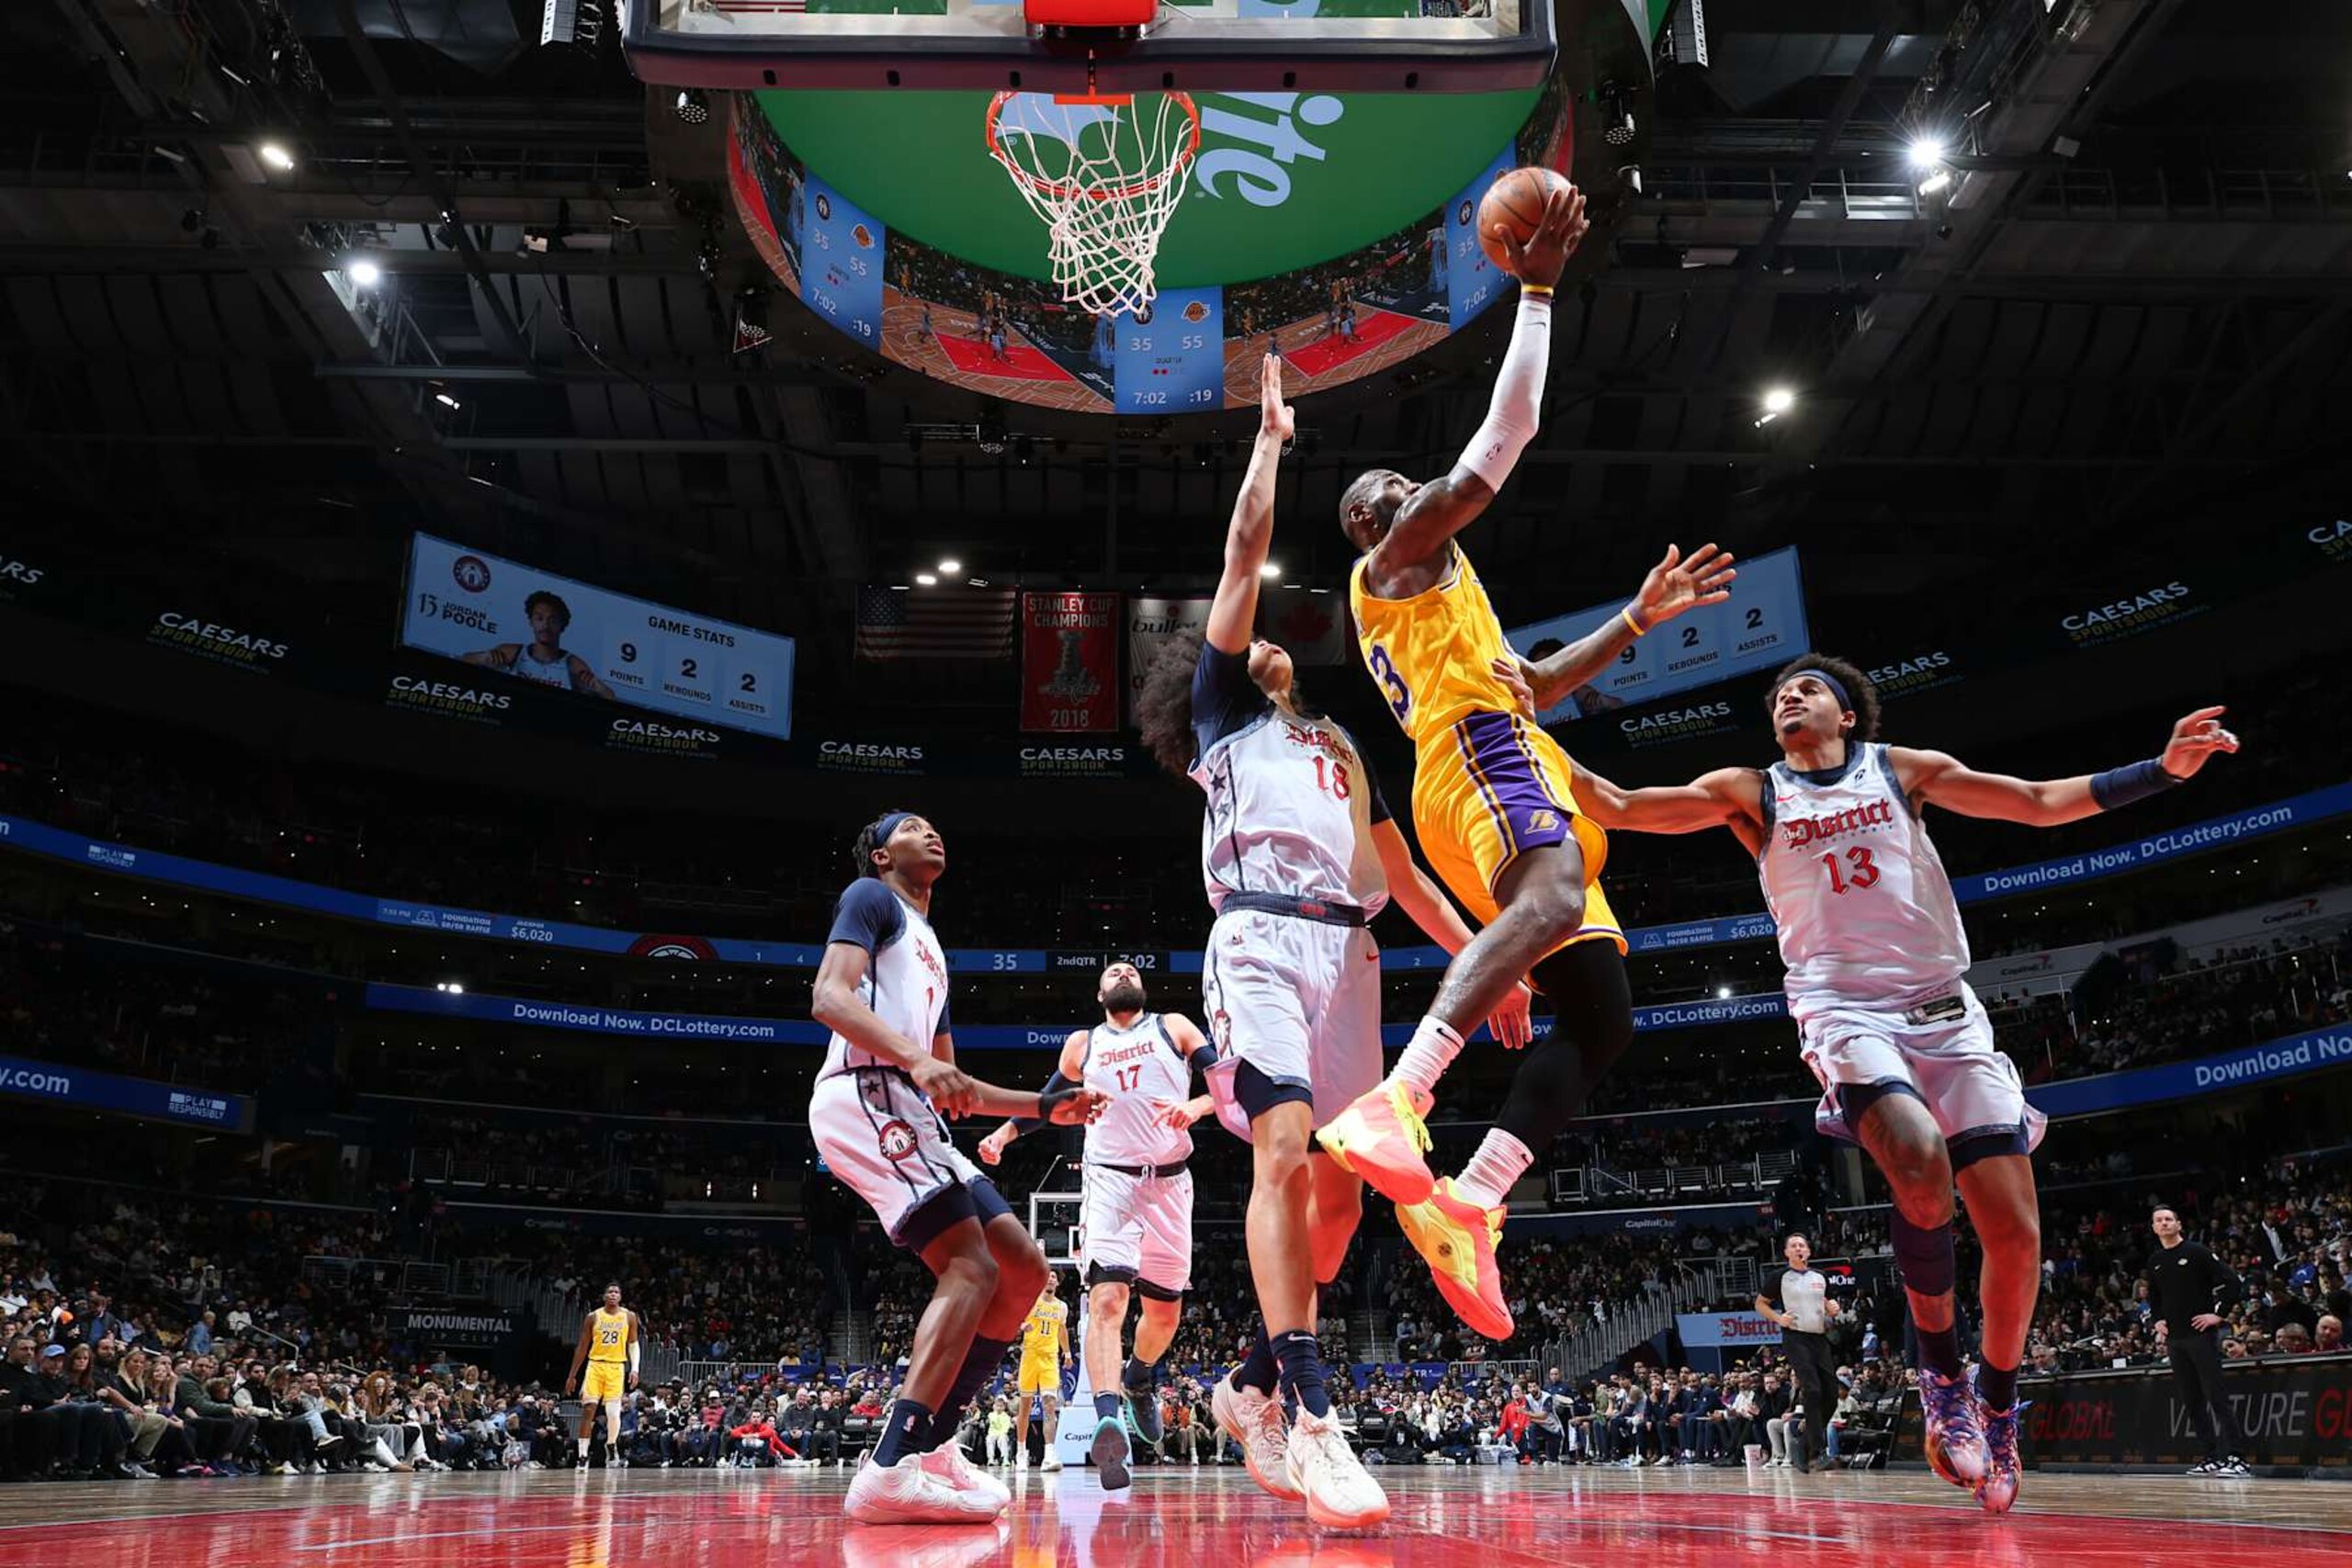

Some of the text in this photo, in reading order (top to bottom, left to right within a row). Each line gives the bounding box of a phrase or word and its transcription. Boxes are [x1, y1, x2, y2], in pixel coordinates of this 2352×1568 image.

[814, 228, 829, 250] 35
[1457, 235, 1475, 257] 35
[850, 255, 866, 276] 55
[813, 288, 836, 315] 7:02
[1463, 286, 1487, 312] 7:02
[853, 319, 871, 337] :19
[1131, 335, 1203, 351] 35 55
[1134, 389, 1212, 404] 7:02 :19
[419, 592, 437, 617] 13
[443, 602, 487, 621] JORDAN
[1028, 598, 1114, 613] STANLEY CUP
[2061, 581, 2189, 632] CAESARS
[443, 610, 498, 635] POOLE
[1034, 614, 1109, 627] CHAMPIONS
[1747, 608, 1763, 629] 2
[2070, 602, 2180, 643] SPORTSBOOK
[158, 611, 289, 660] CAESARS
[649, 615, 736, 648] GAME STATS
[1682, 627, 1699, 648] 2
[149, 624, 256, 662] SPORTSBOOK
[621, 643, 637, 662] 9
[1737, 634, 1778, 652] ASSISTS
[1621, 646, 1636, 664] 9
[1668, 651, 1718, 671] REBOUNDS
[610, 670, 644, 685] POINTS
[682, 659, 696, 678] 2
[1867, 650, 1951, 685] ESARS
[741, 674, 755, 693] 2
[1613, 671, 1648, 687] POINTS
[391, 675, 513, 709] CAESARS
[663, 682, 711, 702] REBOUNDS
[729, 699, 766, 714] ASSISTS
[1050, 709, 1090, 728] 2018
[1620, 702, 1732, 733] CAESARS
[612, 718, 721, 743] CAESARS
[1625, 719, 1716, 743] SPORTSBOOK
[820, 740, 923, 760] CAESARS
[1020, 747, 1124, 761] CAESARS
[1312, 755, 1350, 800] 18
[1785, 797, 1894, 850] District
[1984, 806, 2292, 893] Download Now. DCLottery.com
[1823, 845, 1881, 896] 13
[511, 927, 553, 942] $6,020
[1730, 923, 1773, 940] $6,020
[992, 953, 1017, 971] 35
[1057, 955, 1097, 966] 2ndQTR
[514, 1004, 775, 1038] Download Now. DCLottery.com
[1653, 1001, 1780, 1025] DCLottery.com
[1098, 1041, 1155, 1067] District
[2195, 1042, 2311, 1087] Download
[1116, 1065, 1141, 1091] 17
[168, 1103, 225, 1121] RESPONSIBLY
[185, 1096, 212, 1109] PLAY
[408, 1314, 513, 1333] MONUMENTAL
[1041, 1320, 1050, 1335] 11
[603, 1331, 618, 1344] 28
[2028, 1399, 2115, 1442] GLOBAL
